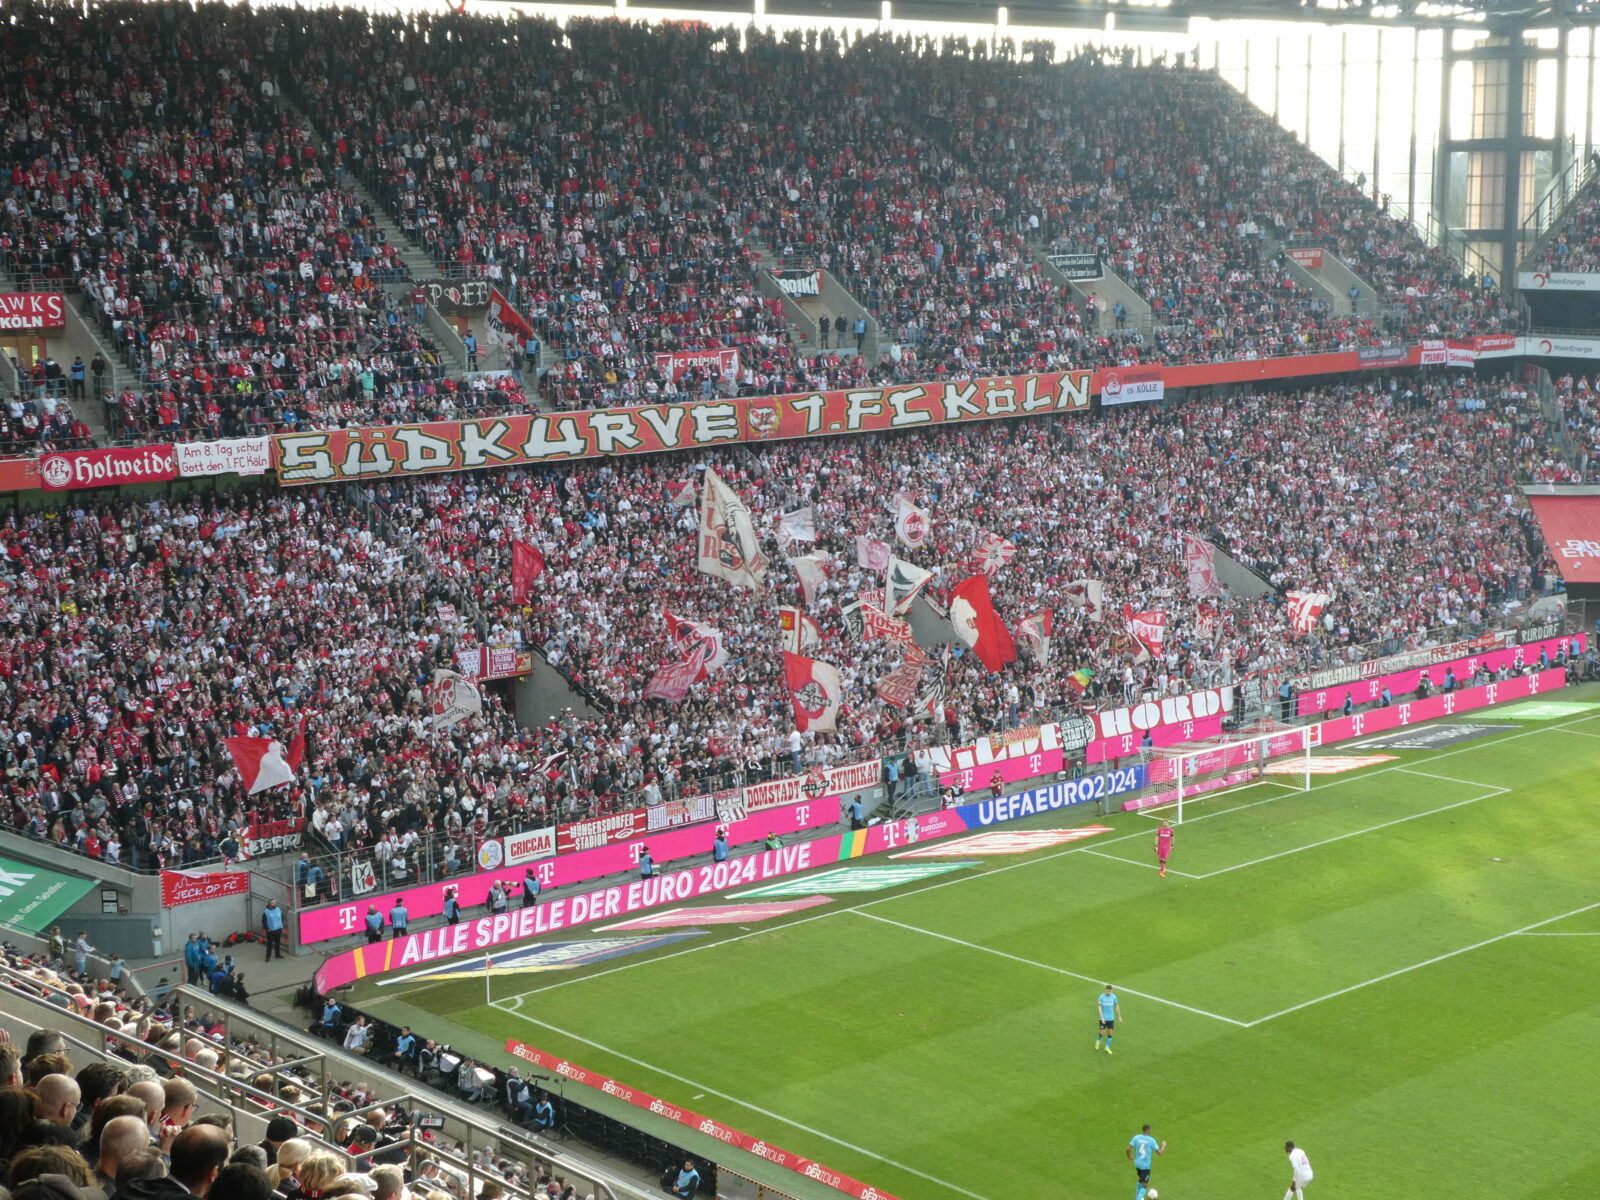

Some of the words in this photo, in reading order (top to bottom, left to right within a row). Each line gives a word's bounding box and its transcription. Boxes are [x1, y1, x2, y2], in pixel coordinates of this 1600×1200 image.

[944, 376, 1090, 419] KÖLN
[184, 446, 200, 457] Am
[205, 447, 213, 456] 8.
[216, 445, 232, 455] Tag
[236, 442, 263, 453] schuf
[280, 403, 741, 481] SÜDKURVE
[74, 452, 174, 484] Holweide
[182, 459, 203, 473] Gott
[207, 459, 223, 470] den
[233, 457, 246, 468] FC
[247, 454, 267, 467] Köln
[747, 780, 800, 808] DOMSTADT
[830, 763, 879, 791] SYNDIKAT
[570, 813, 634, 838] MÜNGERSDORFER
[510, 835, 551, 857] CRICCAA
[575, 834, 608, 851] STADION
[173, 889, 203, 900] JECK
[205, 885, 220, 894] OP
[223, 881, 238, 890] FC
[401, 922, 470, 966] ALLE
[475, 899, 566, 947] SPIELE
[570, 886, 622, 925] DER
[627, 869, 694, 911] EURO
[698, 854, 757, 894] 2024
[762, 841, 812, 878] LIVE
[556, 1061, 586, 1082] DERTOUR
[602, 1080, 633, 1102] DERTOUR
[650, 1099, 682, 1121] DERTOUR
[700, 1119, 733, 1143] DERTOUR
[751, 1141, 786, 1166] DERTOUR
[805, 1163, 841, 1188] DERTOUR
